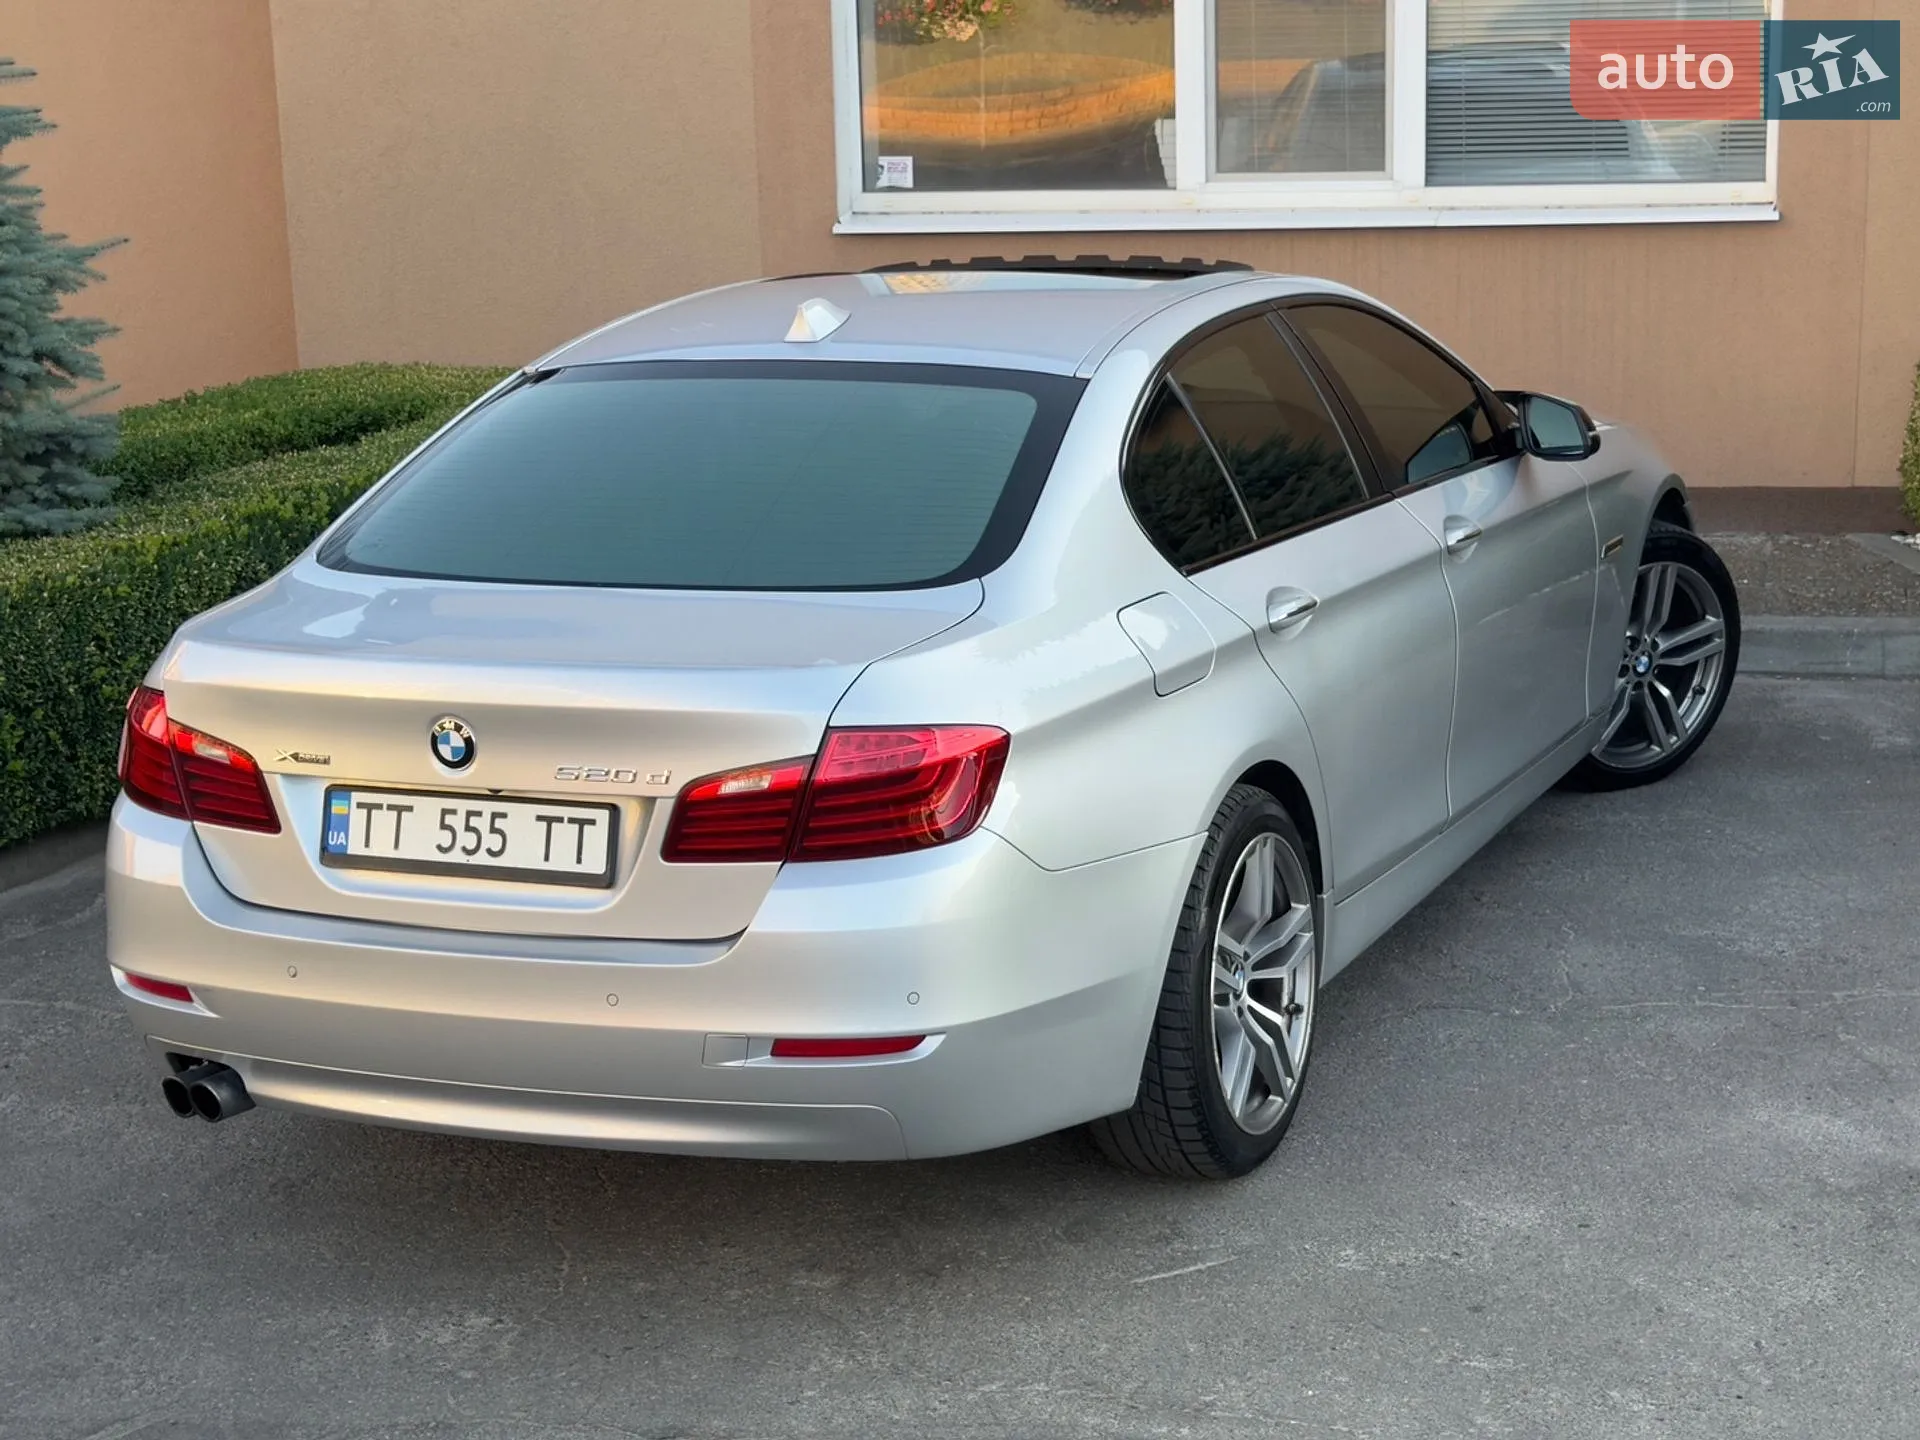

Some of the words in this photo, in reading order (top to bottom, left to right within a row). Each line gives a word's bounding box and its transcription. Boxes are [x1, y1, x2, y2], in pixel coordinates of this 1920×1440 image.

[433, 720, 471, 739] BMW
[328, 830, 346, 846] UA
[356, 802, 414, 850] TT
[435, 807, 508, 858] 555
[535, 814, 597, 865] TT
